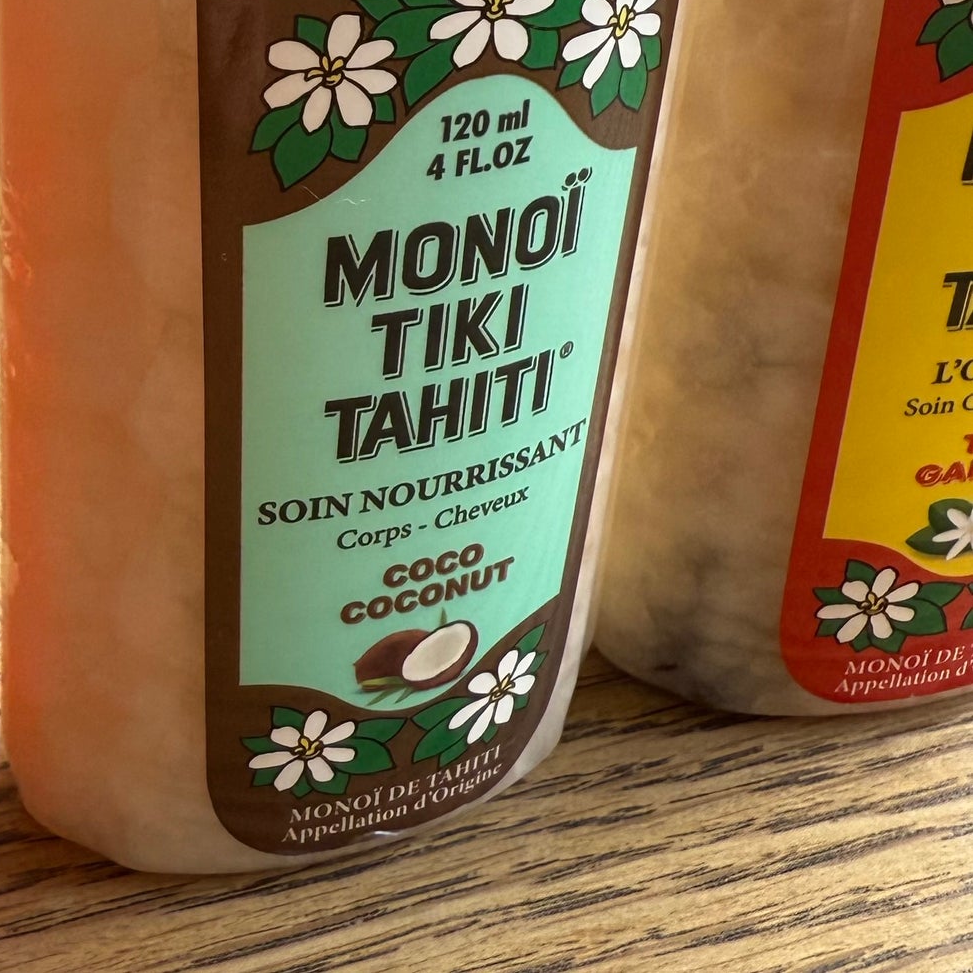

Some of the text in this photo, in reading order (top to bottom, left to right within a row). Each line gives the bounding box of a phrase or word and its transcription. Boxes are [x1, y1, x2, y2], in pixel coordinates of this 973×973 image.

[440, 99, 530, 143] 120 ml
[426, 135, 534, 181] 4 FL.OZ
[323, 166, 593, 308] MONOÏ
[371, 283, 529, 380] TIKI
[904, 397, 955, 417] Soin
[257, 418, 587, 526] SOIN NOURRISSANT
[336, 521, 412, 551] Corps
[434, 485, 530, 530] Cheveux
[340, 556, 516, 626] COCONUT
[382, 542, 485, 588] COCO
[835, 670, 950, 696] Appellation
[845, 645, 966, 676] MONOÏ DE
[282, 762, 503, 844] Appellation d'Origine
[289, 744, 502, 824] MONOÏ DE TAHITI
